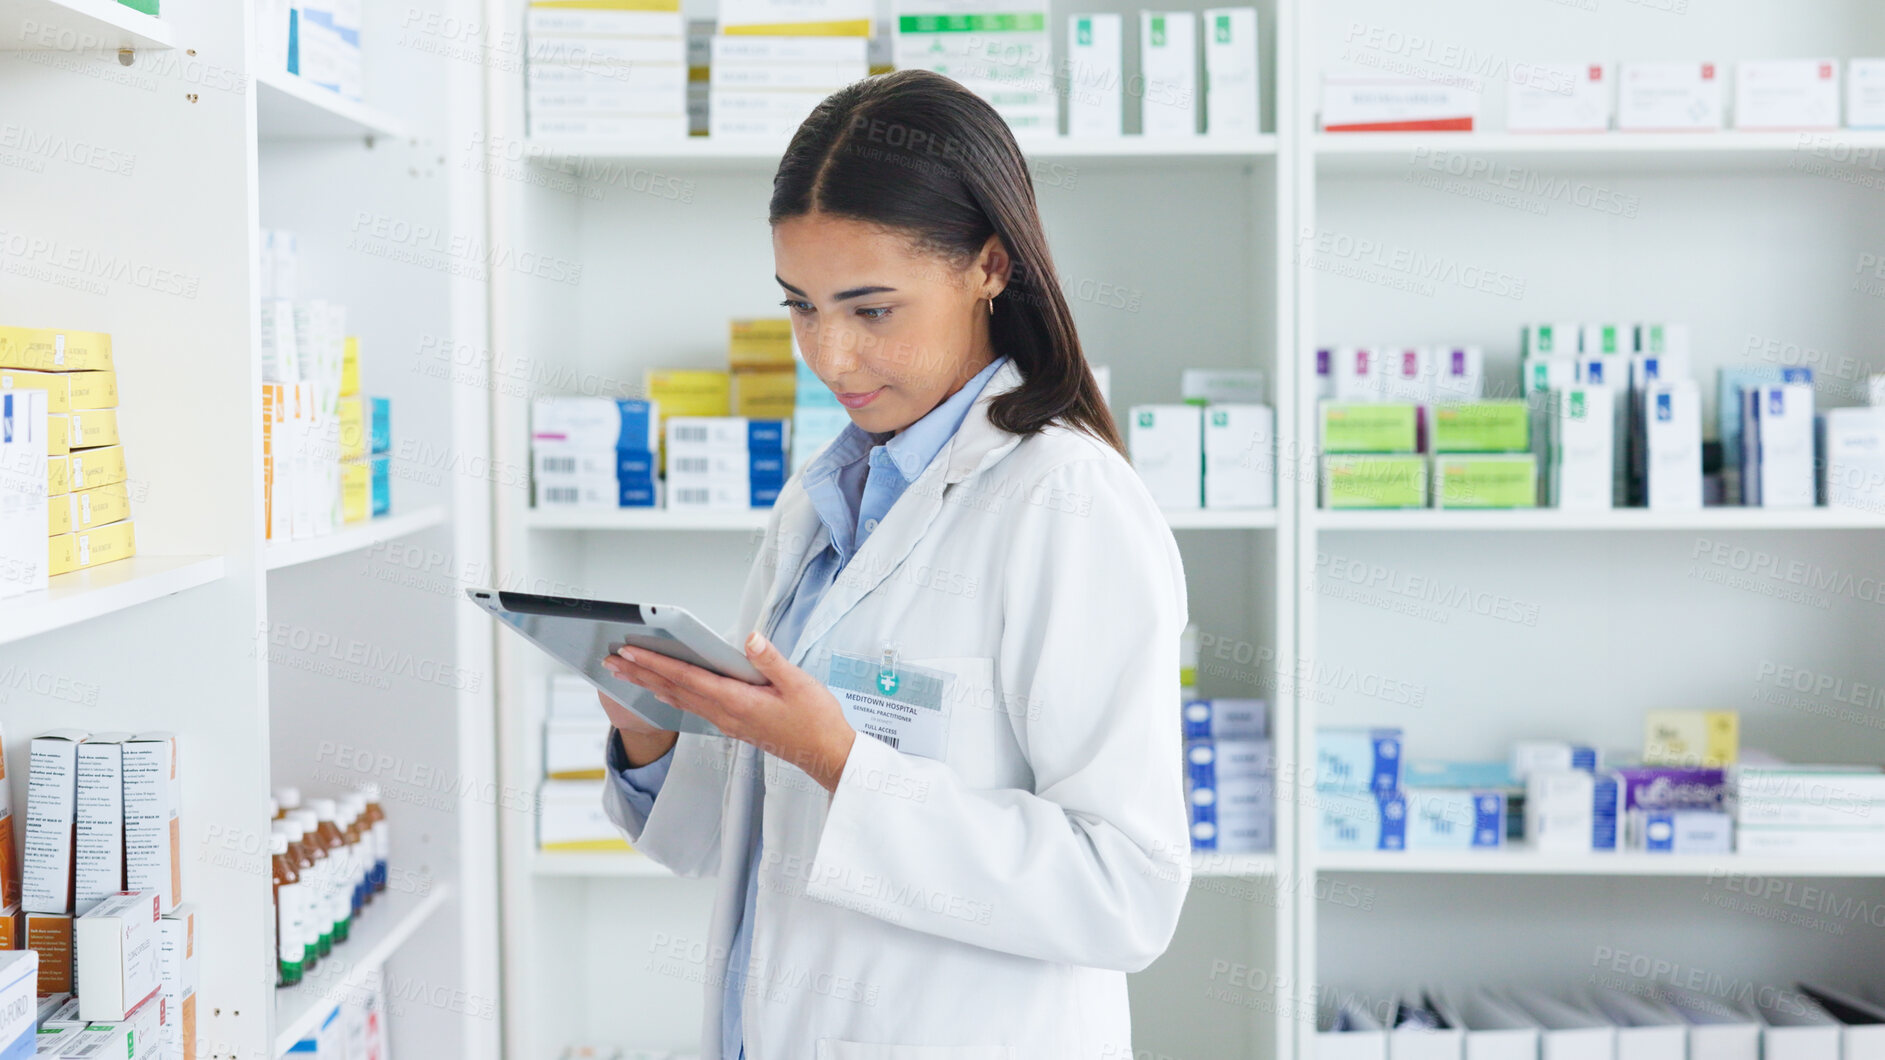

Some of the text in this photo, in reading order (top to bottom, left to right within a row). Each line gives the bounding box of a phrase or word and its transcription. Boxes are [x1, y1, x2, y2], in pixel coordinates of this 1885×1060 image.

[846, 693, 918, 715] MEDITOWN HOSPITAL
[853, 704, 876, 714] GENERAL
[876, 709, 912, 722] PRACTITIONER
[864, 723, 898, 735] FULL ACCESS
